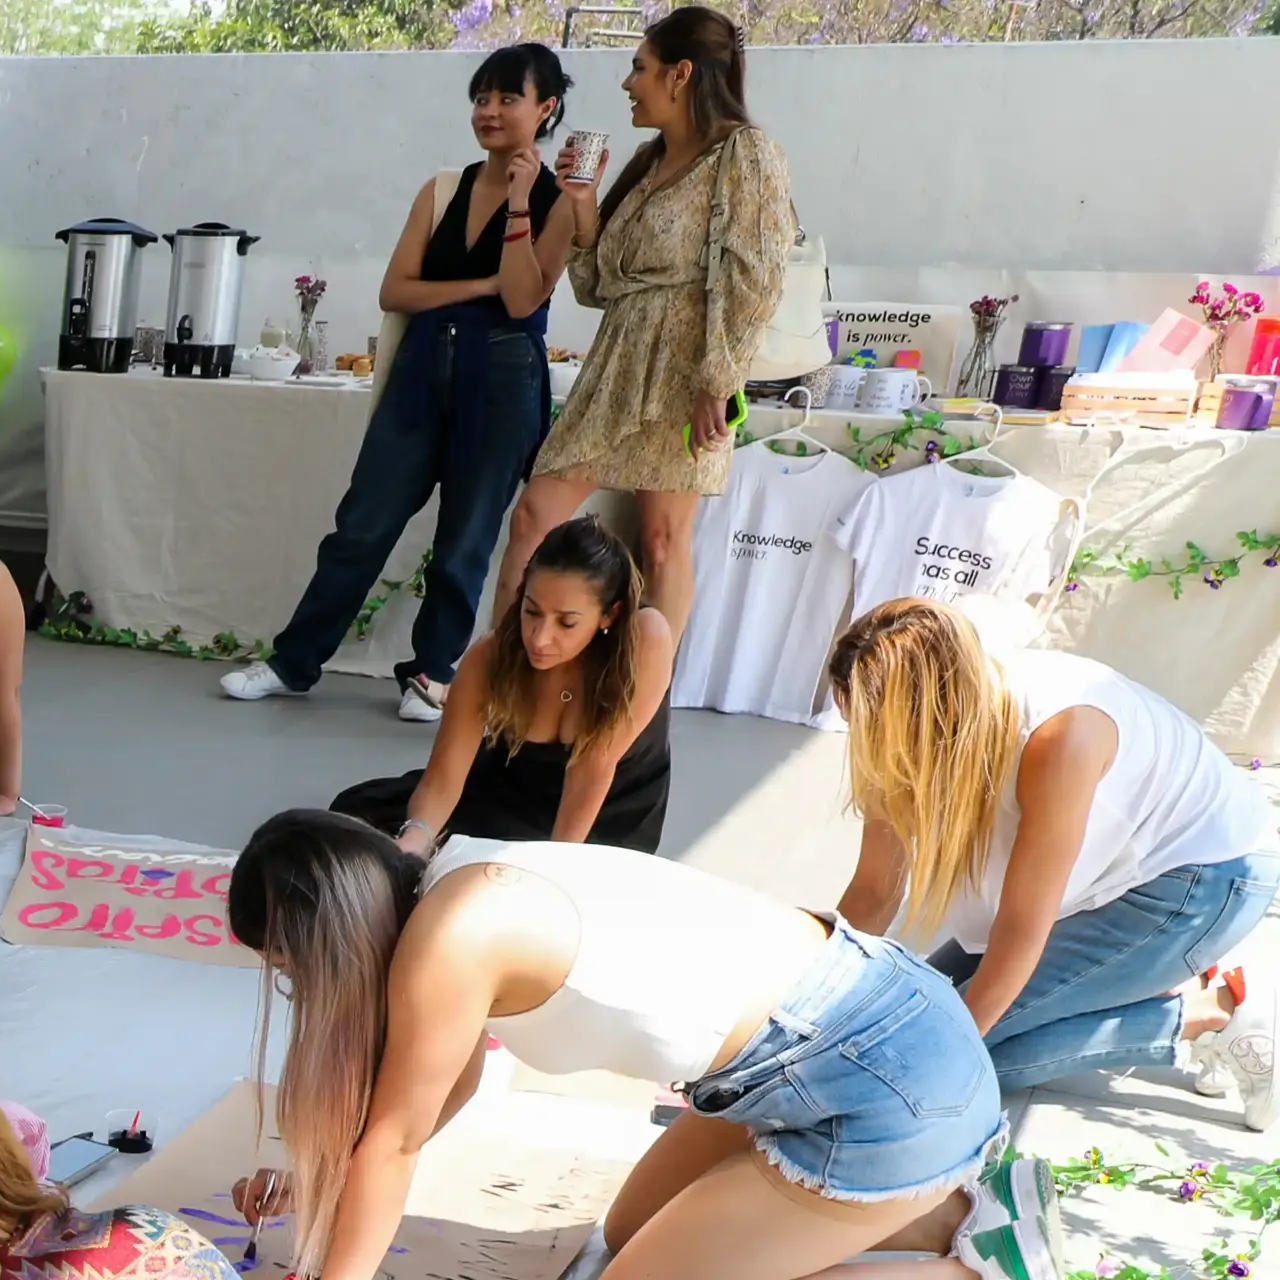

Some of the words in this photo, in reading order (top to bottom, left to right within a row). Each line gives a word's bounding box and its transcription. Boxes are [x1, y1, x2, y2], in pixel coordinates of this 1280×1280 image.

[836, 310, 931, 328] knowledge
[846, 329, 860, 343] is
[862, 331, 912, 347] power.
[732, 530, 812, 555] Knowledge
[914, 536, 993, 570] Success
[954, 569, 979, 588] all
